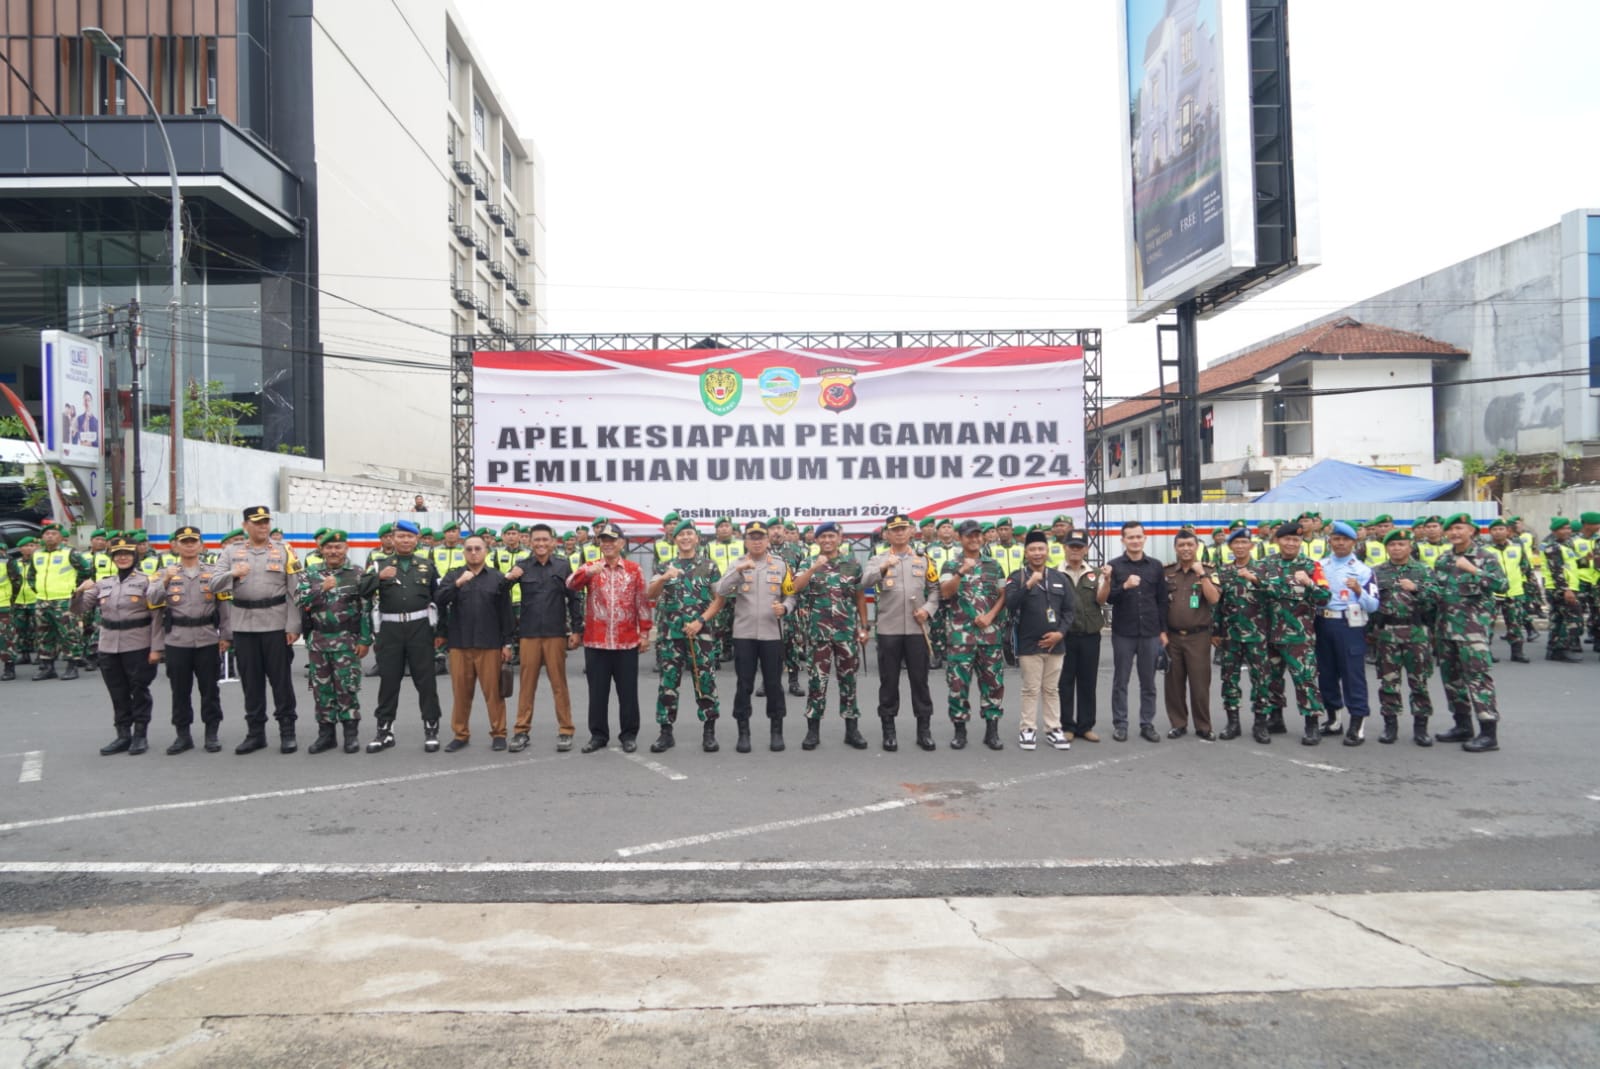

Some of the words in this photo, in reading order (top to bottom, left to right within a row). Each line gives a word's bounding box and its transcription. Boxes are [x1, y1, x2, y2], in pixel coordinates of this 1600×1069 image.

[1180, 211, 1197, 233] FREE
[497, 426, 588, 449] APEL
[597, 424, 785, 448] KESIAPAN
[795, 421, 1058, 446] PENGAMANAN
[487, 458, 698, 483] PEMILIHAN
[706, 457, 828, 481] UMUM
[837, 455, 963, 479] TAHUN
[972, 453, 1072, 478] 2024
[673, 507, 770, 518] Tasikmalaya,
[774, 507, 790, 518] 10
[794, 506, 857, 517] Februari
[861, 505, 898, 516] 2024
